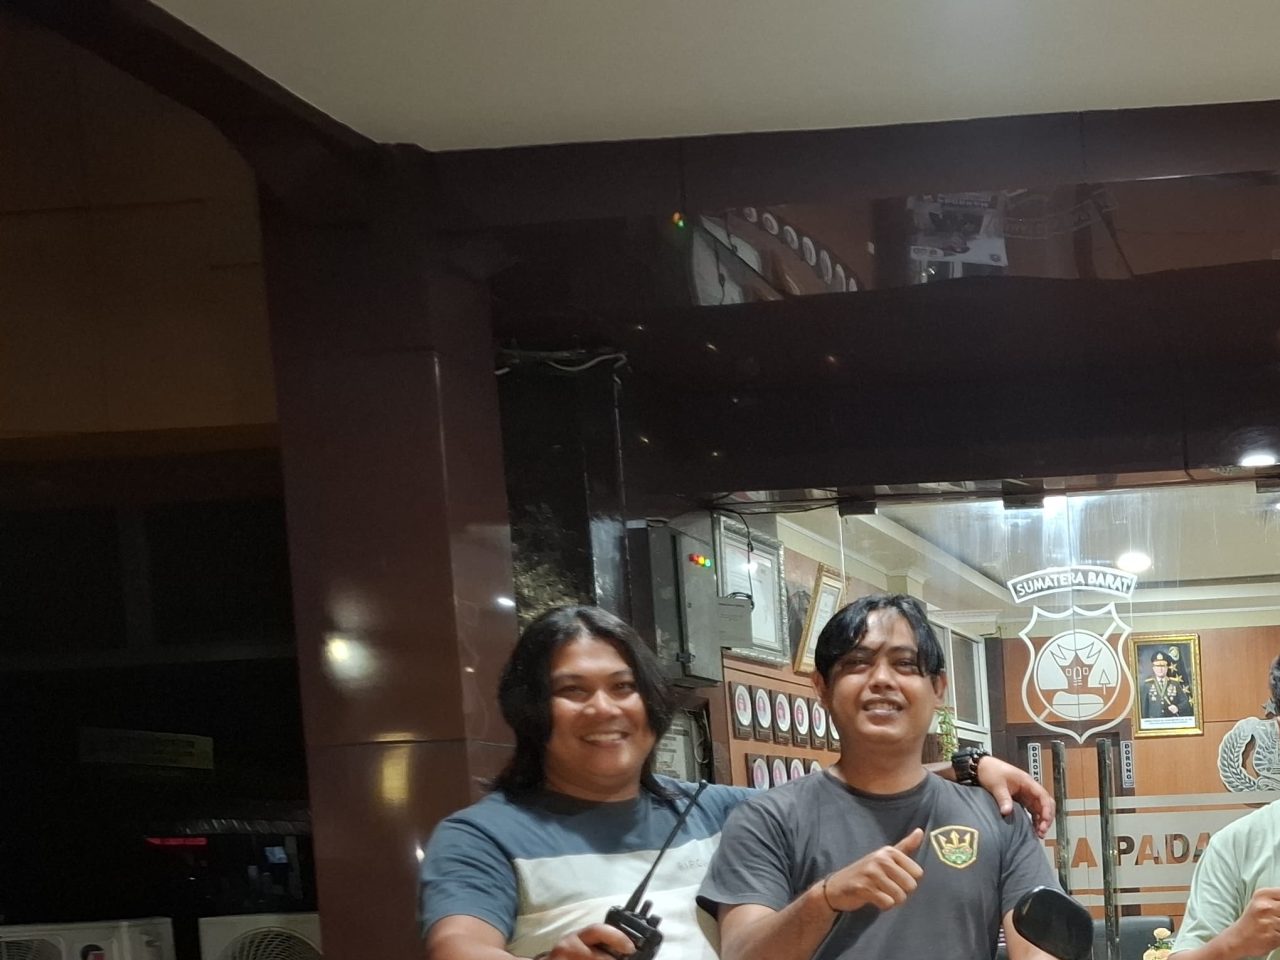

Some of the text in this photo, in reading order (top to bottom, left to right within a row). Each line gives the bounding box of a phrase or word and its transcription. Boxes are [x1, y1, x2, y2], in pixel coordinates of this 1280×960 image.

[1016, 571, 1131, 596] SUMATERA BARAT
[1124, 743, 1132, 780] DORONG
